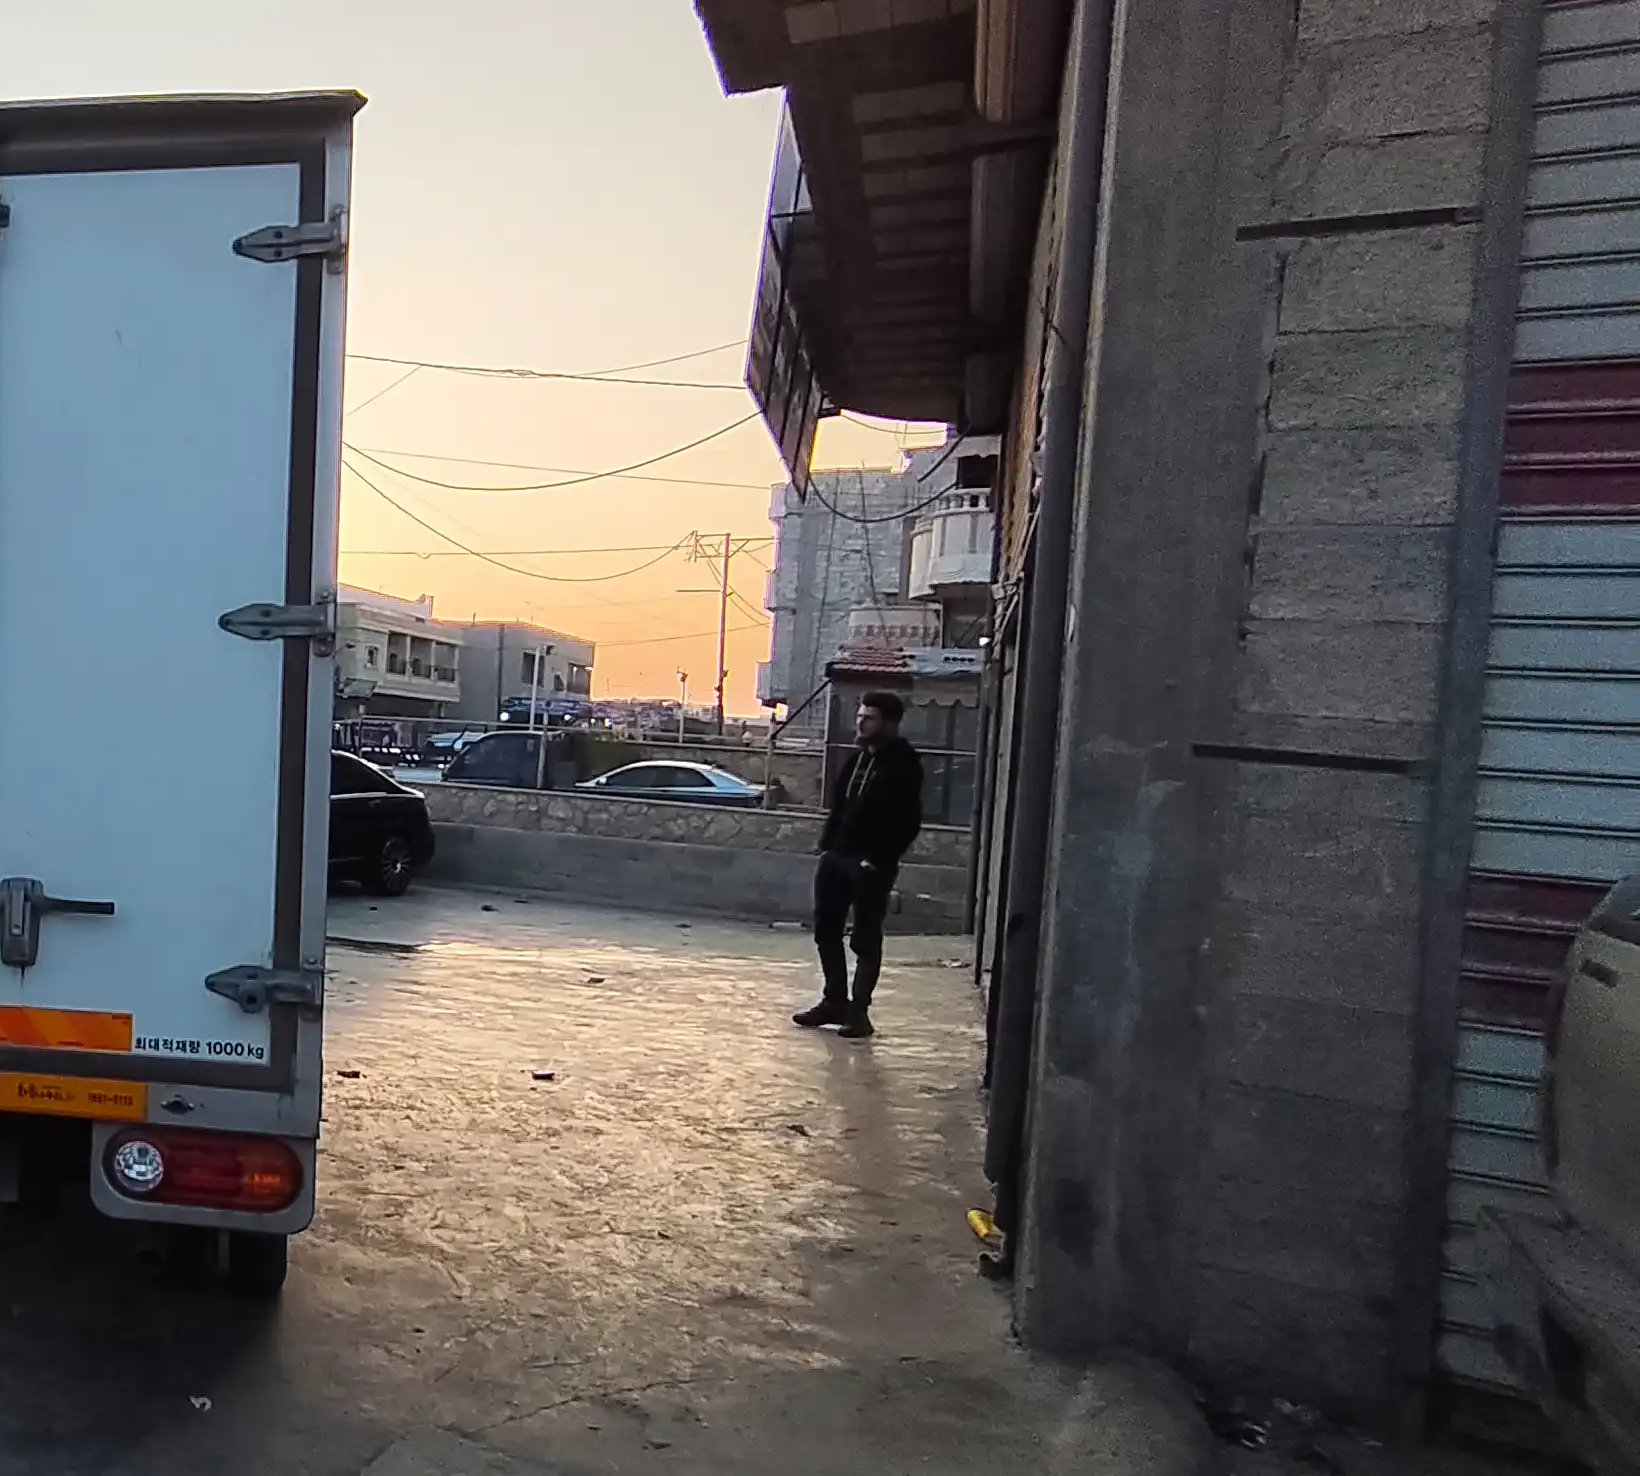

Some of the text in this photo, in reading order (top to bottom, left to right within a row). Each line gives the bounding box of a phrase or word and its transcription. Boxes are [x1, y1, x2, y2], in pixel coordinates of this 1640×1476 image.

[135, 1037, 265, 1060] 최대적재량 1000 kg
